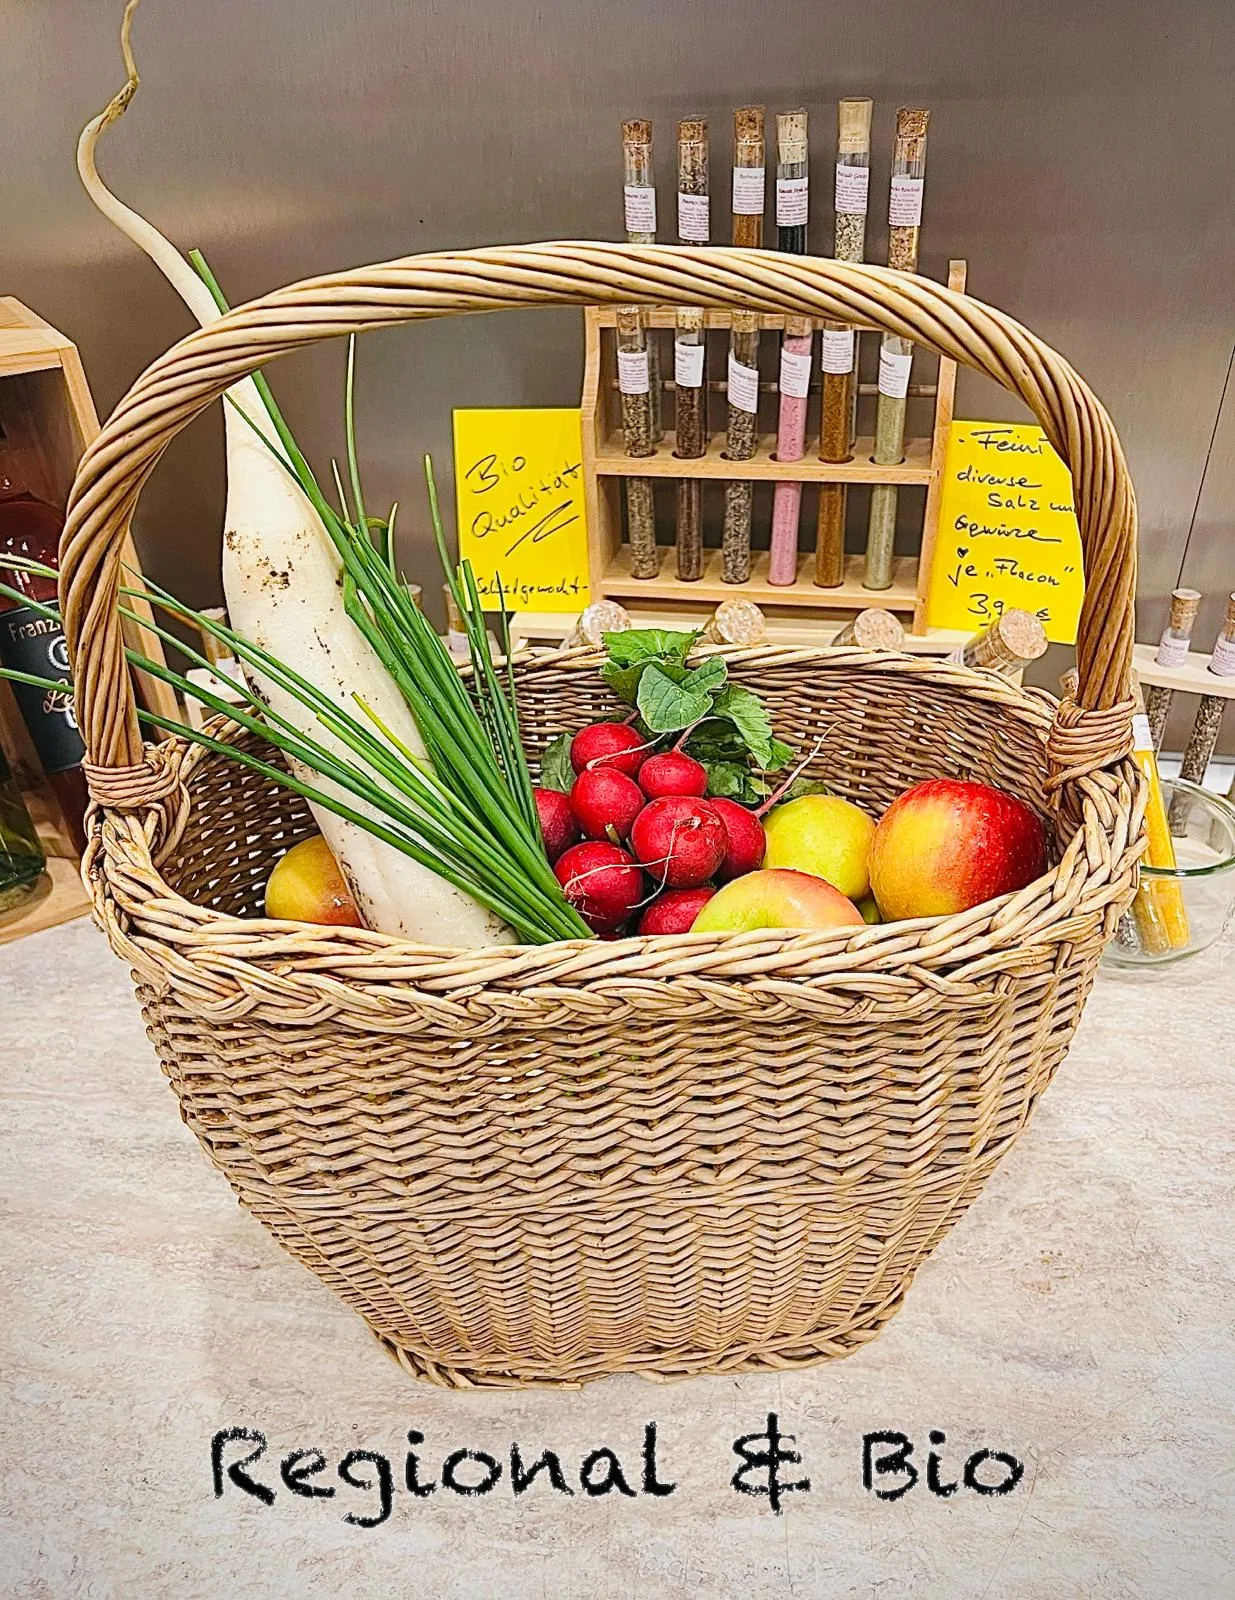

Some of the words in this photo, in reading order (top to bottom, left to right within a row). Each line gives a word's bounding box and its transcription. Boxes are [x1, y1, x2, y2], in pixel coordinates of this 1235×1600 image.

[465, 454, 526, 494] Bio
[957, 464, 1042, 488] diverse
[471, 460, 582, 538] Qualität
[988, 492, 1040, 511] Salz
[954, 514, 1062, 543] Gewürze
[947, 563, 978, 588] je
